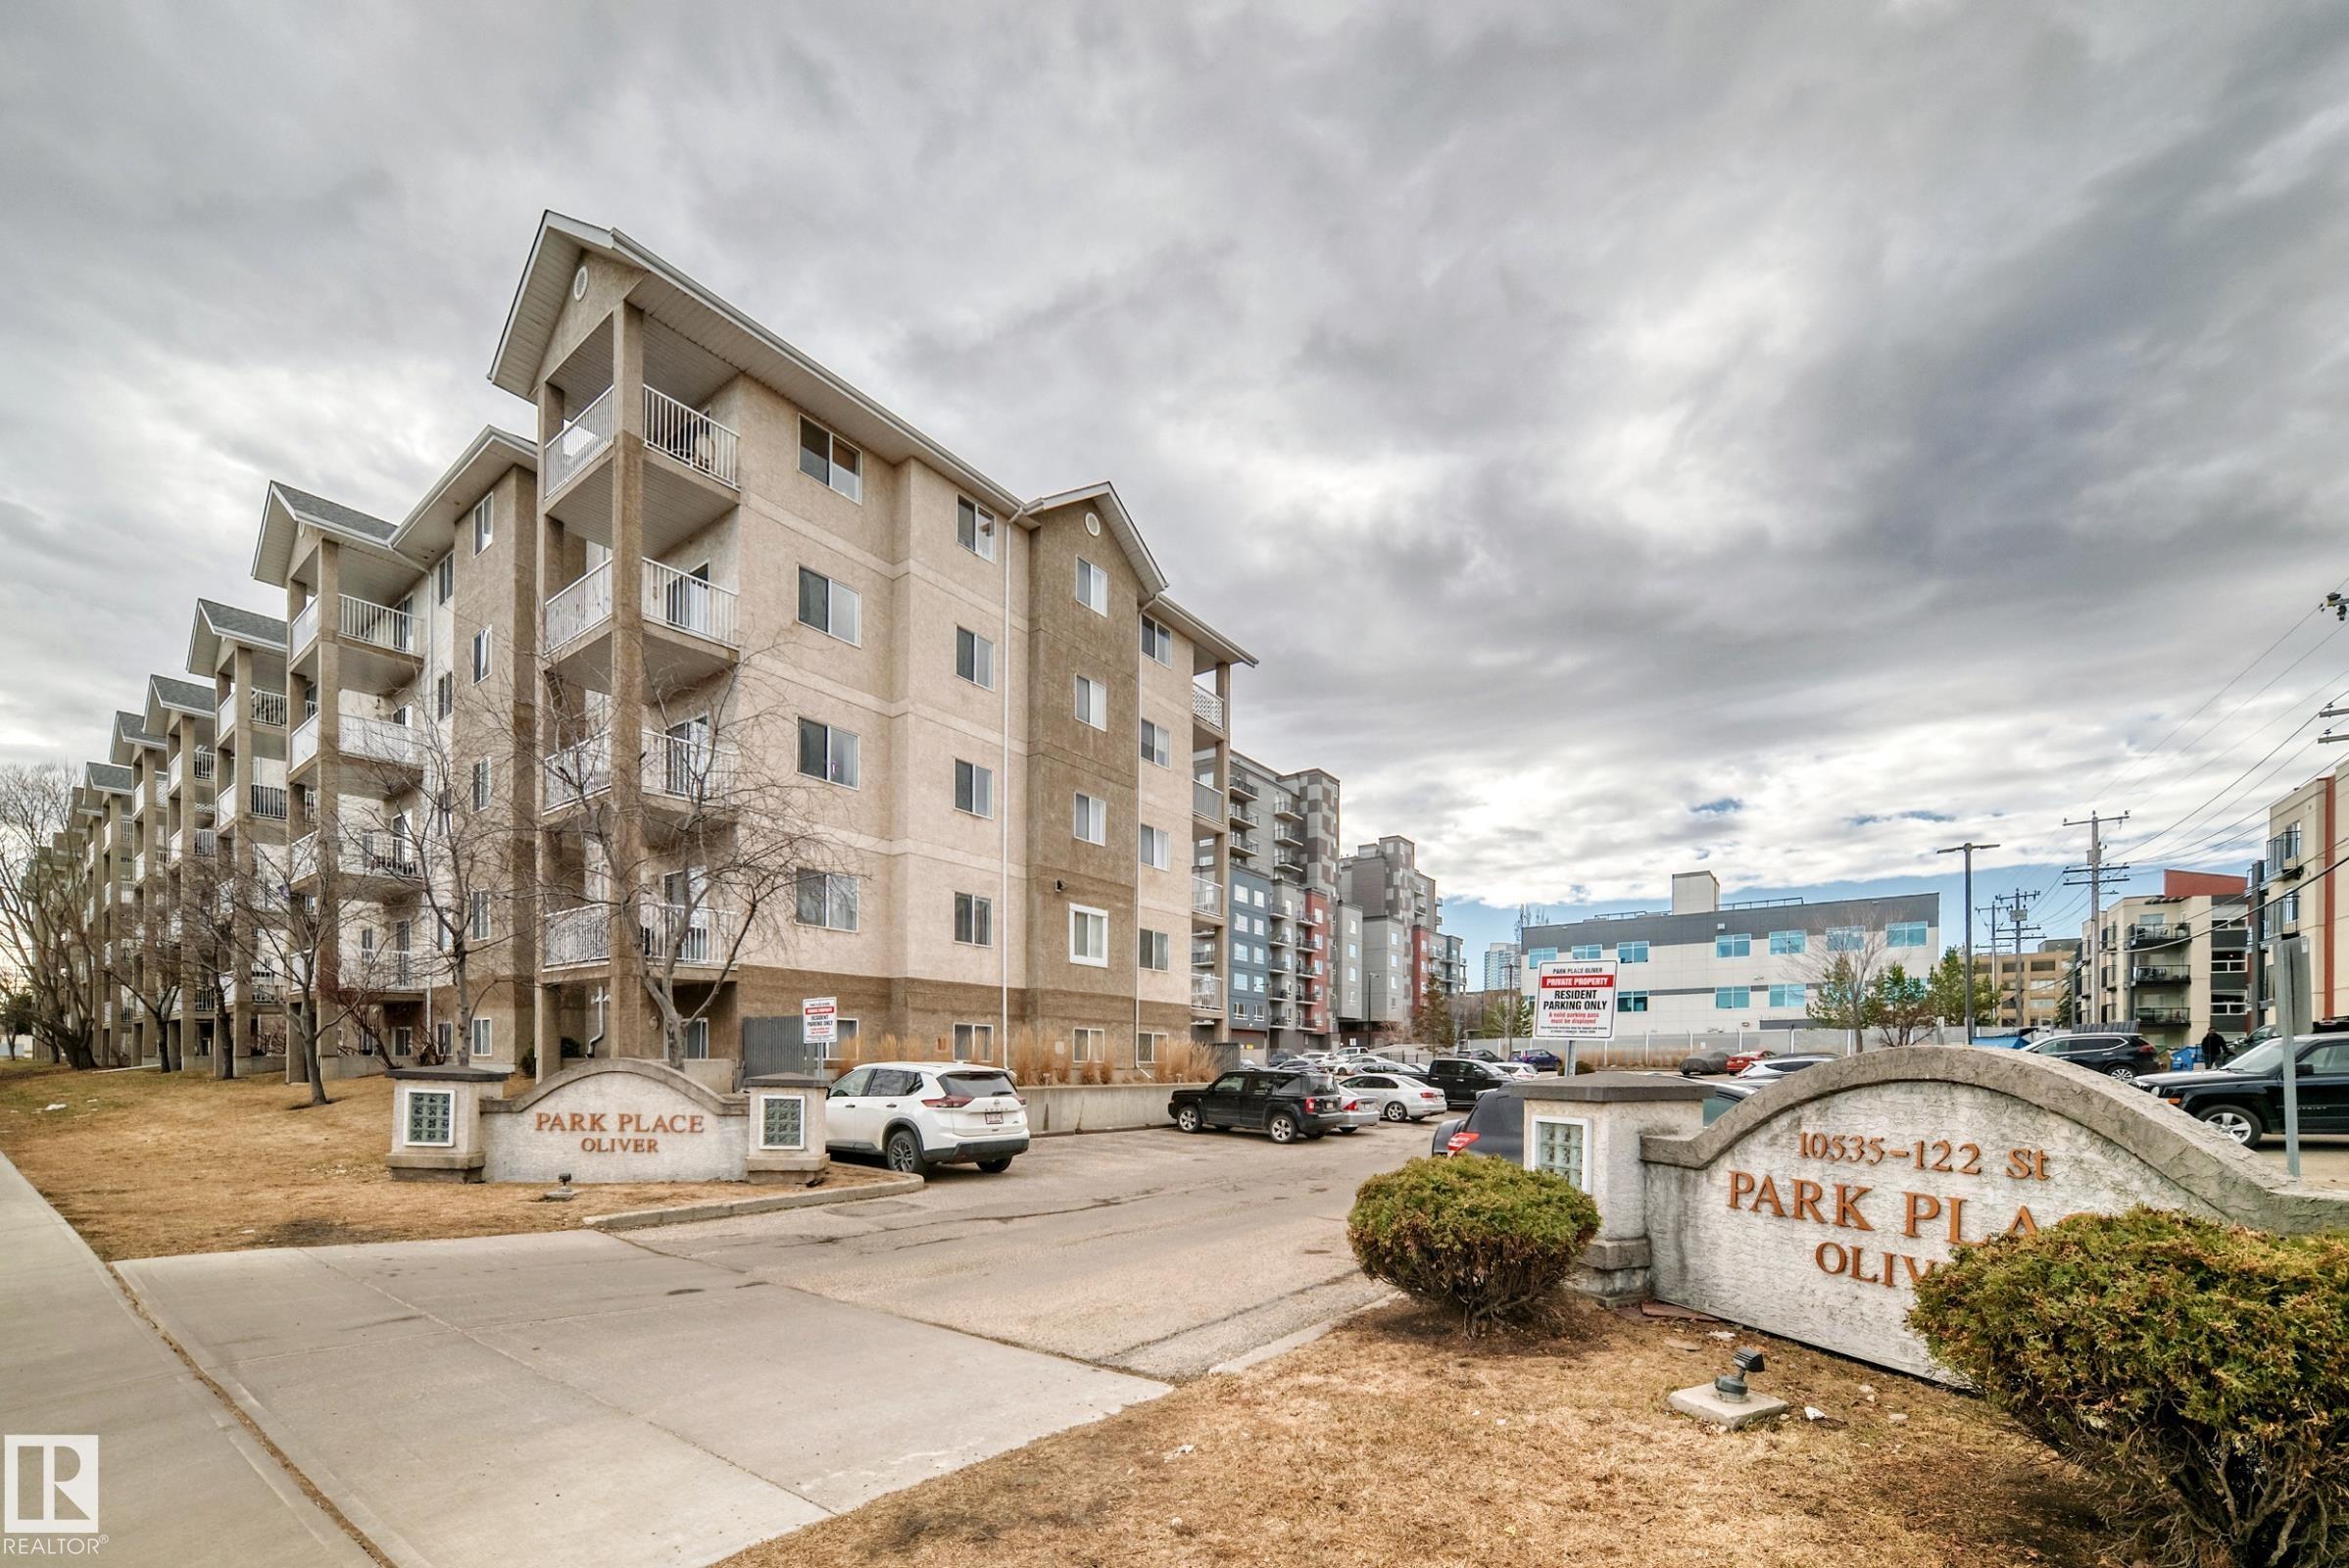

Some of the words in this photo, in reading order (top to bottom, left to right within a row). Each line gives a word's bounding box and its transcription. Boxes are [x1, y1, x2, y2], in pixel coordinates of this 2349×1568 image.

[1574, 977, 1608, 986] PROPERTY
[1554, 990, 1597, 1000] RESIDENT
[1543, 1001, 1582, 1009] PARKING
[1584, 1001, 1607, 1009] ONLY
[534, 1112, 609, 1132] PARK
[617, 1113, 705, 1134] PLACE
[580, 1137, 660, 1153] OLIVER
[1797, 1132, 1982, 1175] 10535-122
[2005, 1147, 2050, 1182] St
[1726, 1170, 1875, 1233] PARK
[1900, 1191, 2109, 1249] PLA
[1814, 1241, 1937, 1288] OLIV
